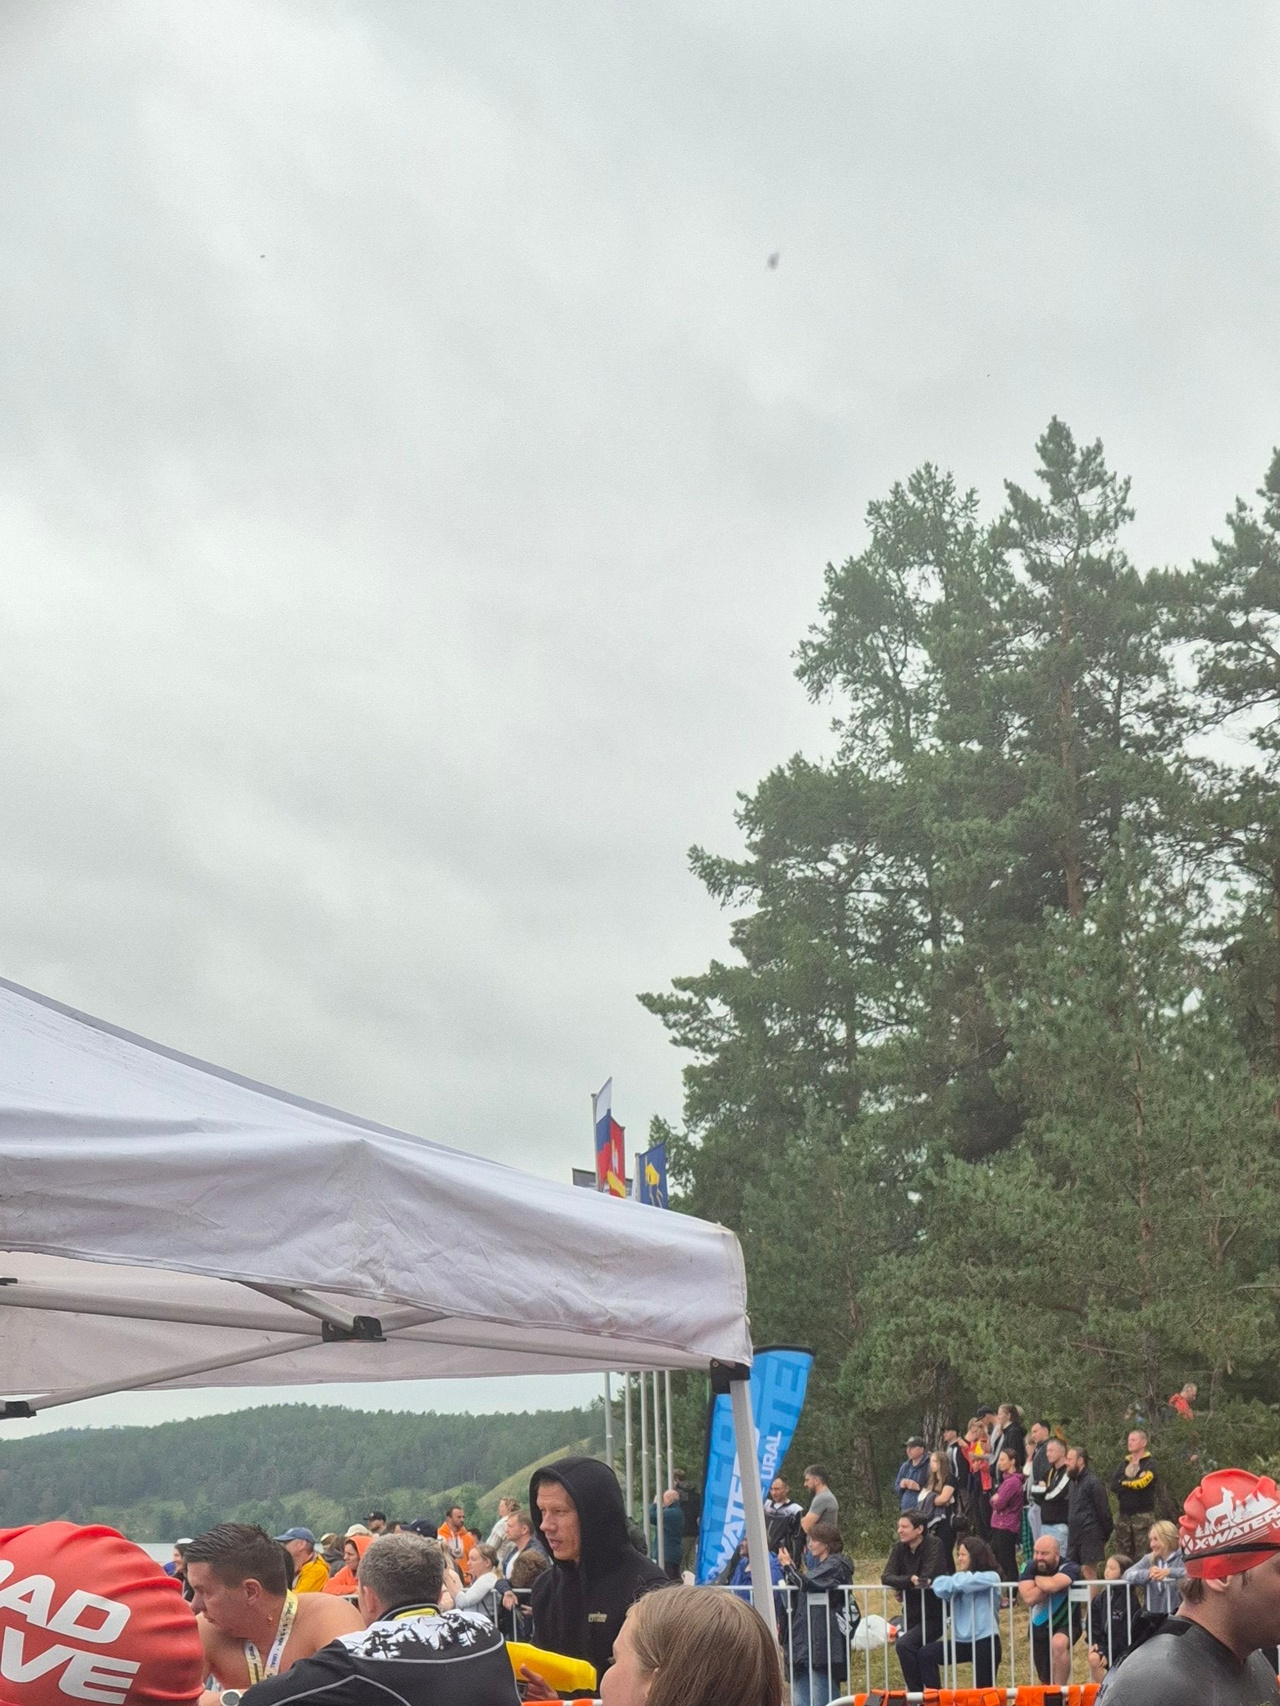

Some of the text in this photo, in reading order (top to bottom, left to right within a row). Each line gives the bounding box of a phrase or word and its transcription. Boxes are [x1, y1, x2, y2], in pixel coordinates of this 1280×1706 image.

[760, 1430, 782, 1480] URAL
[0, 1559, 131, 1644] AD
[0, 1626, 141, 1705] VE
